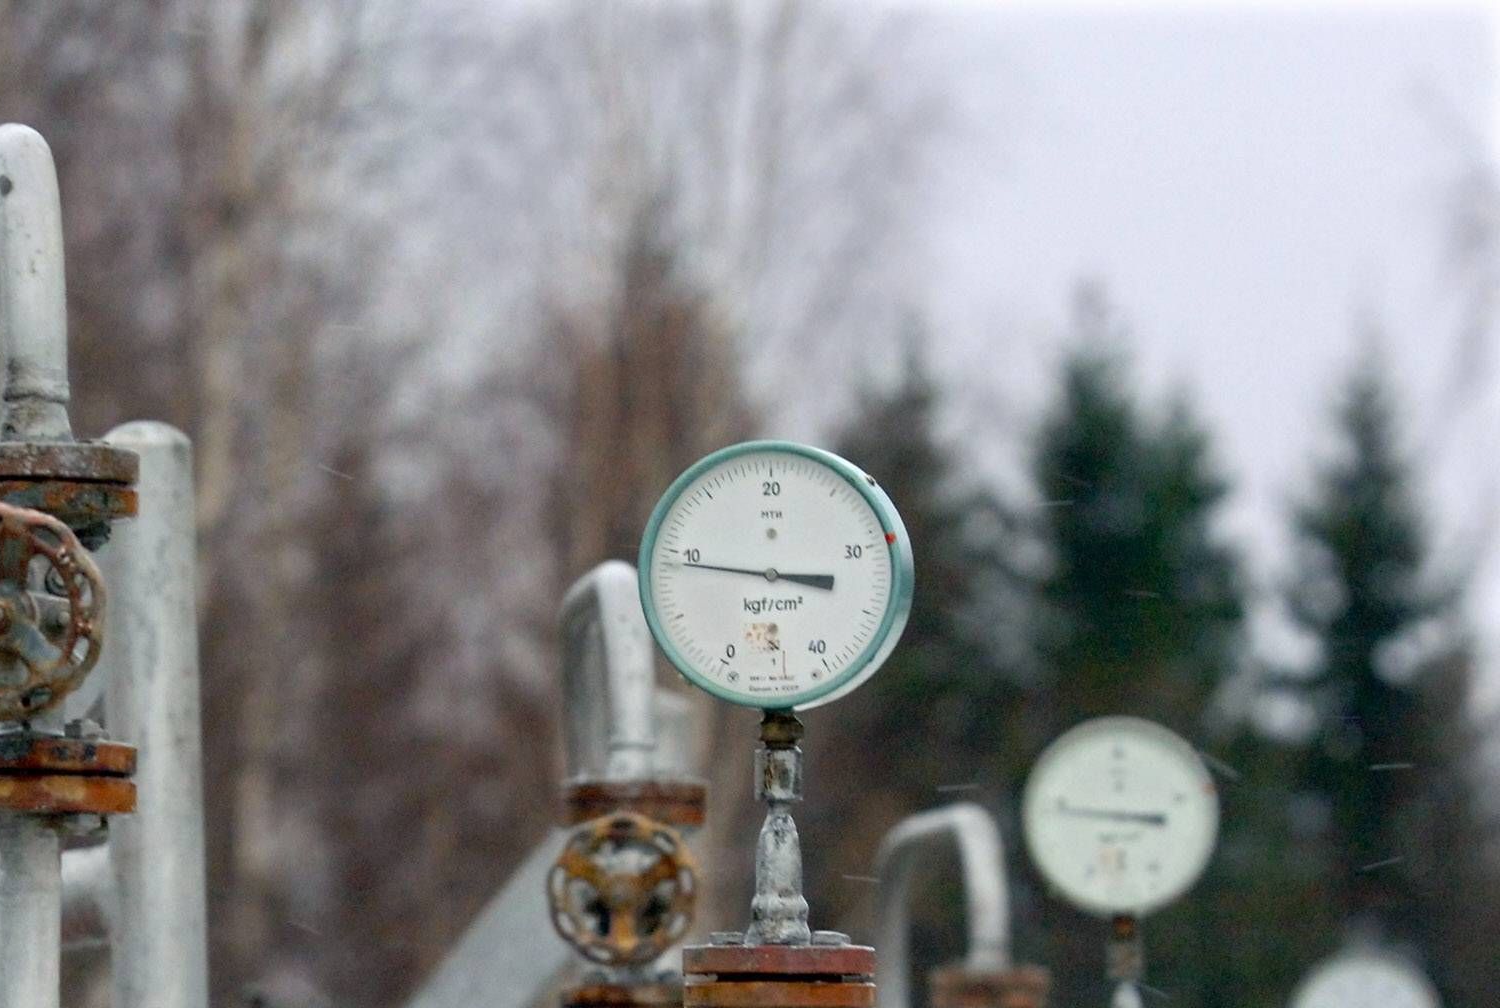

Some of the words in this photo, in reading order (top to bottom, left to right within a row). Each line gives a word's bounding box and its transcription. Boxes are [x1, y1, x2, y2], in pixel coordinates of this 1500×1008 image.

[762, 481, 781, 496] 20
[683, 548, 700, 563] 10
[844, 544, 862, 559] 30
[726, 644, 735, 658] 0
[808, 639, 826, 655] 40
